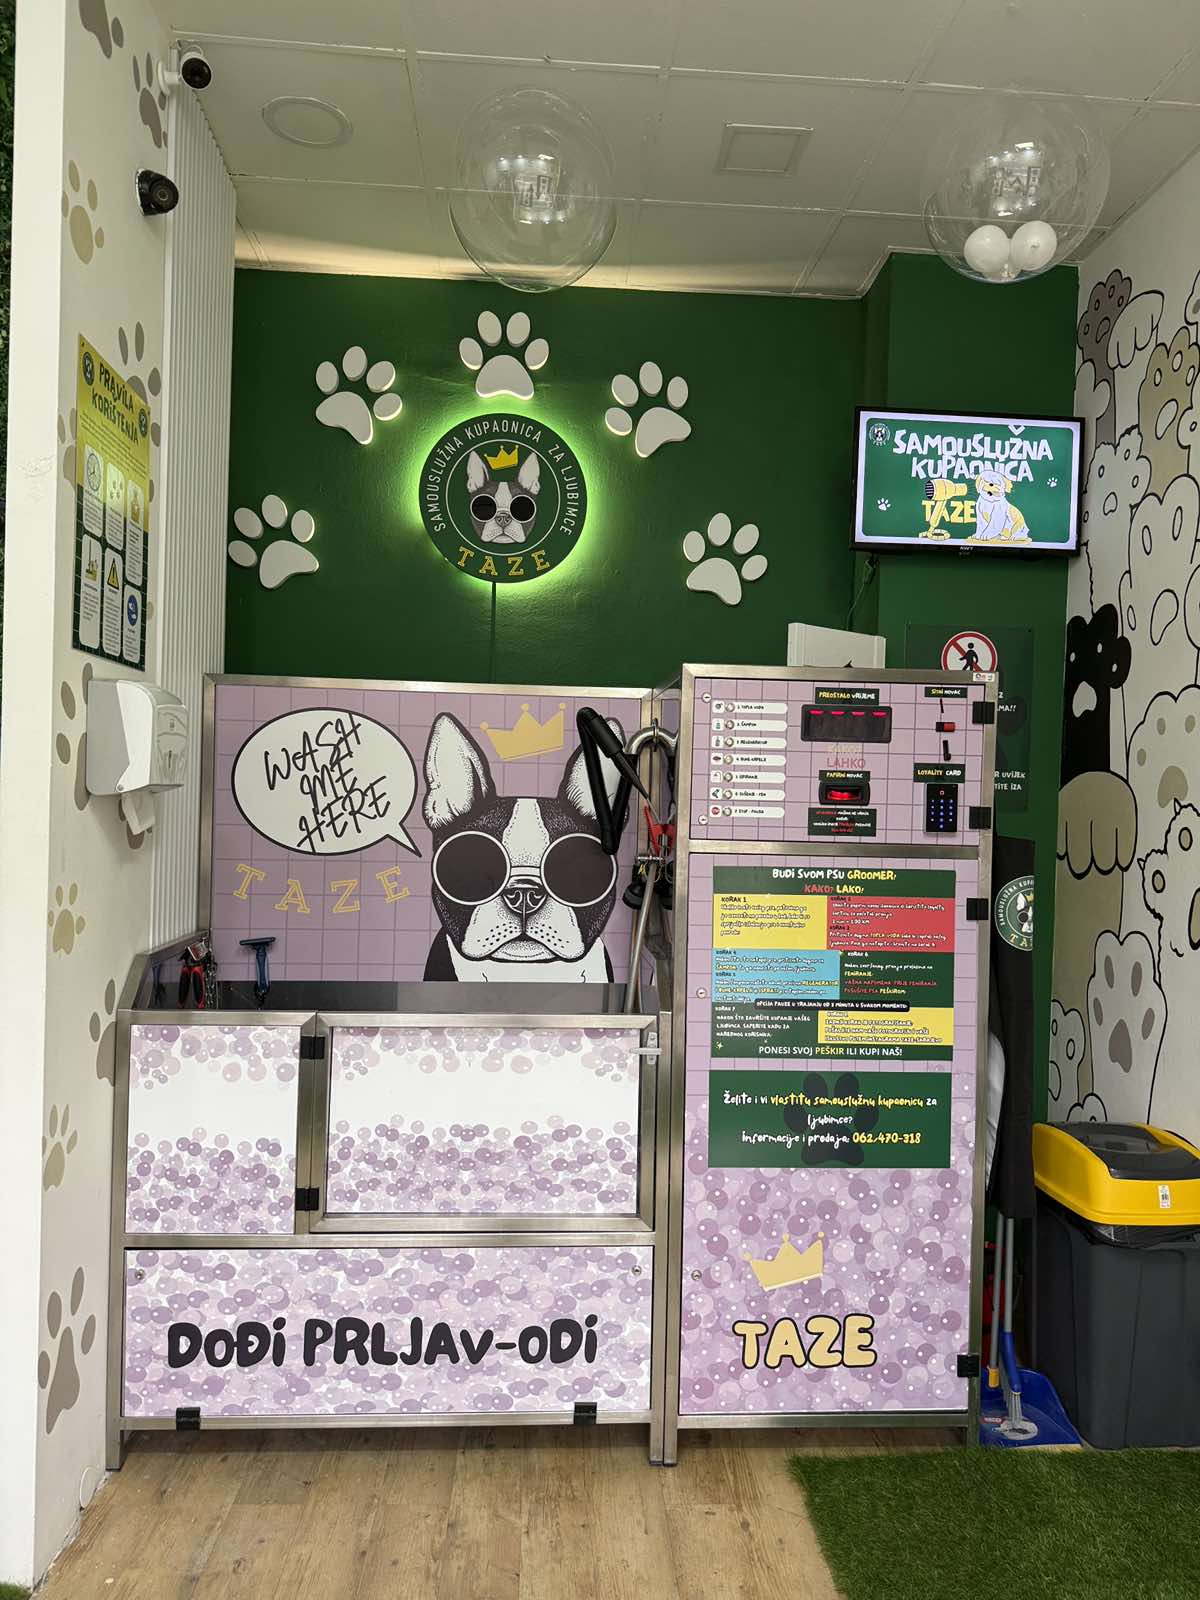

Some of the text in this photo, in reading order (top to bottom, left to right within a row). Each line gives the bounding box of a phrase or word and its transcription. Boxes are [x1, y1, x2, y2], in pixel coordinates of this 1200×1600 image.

[99, 361, 134, 413] PRAVILA
[892, 424, 1055, 463] SAMOUSLUŽNA
[426, 420, 580, 536] SAMOUSLUŽNA KUPAONICA ZA LJUBIMCE
[458, 547, 551, 577] TAZE
[818, 691, 876, 700] PREOSTALO VRIJEME
[996, 704, 1017, 712] MA!!
[264, 712, 362, 791] WASH
[299, 748, 358, 815] ME
[917, 768, 943, 776] LOYALITY
[1001, 770, 1026, 779] UVIJEK
[1010, 782, 1022, 790] IZA
[297, 776, 391, 854] HERE
[772, 868, 795, 879] BUDI
[797, 869, 825, 879] SVOM
[826, 869, 845, 879] PSU
[233, 863, 411, 915] TAZE
[836, 884, 865, 894] LAKO!
[1009, 932, 1034, 948] TA
[758, 1045, 903, 1057] PONESI SVOJ PEŠKIR ILI KUPI NAŠ!
[723, 1089, 938, 1109] Želite i vi vlastitu samouslužnu kupaonicu za
[807, 1113, 853, 1130] ljubimce?
[741, 1130, 801, 1149] Informacije
[802, 1132, 807, 1144] i
[167, 1313, 599, 1369] DOĐI PRLJAV-ODI
[731, 1313, 878, 1370] TAZE
